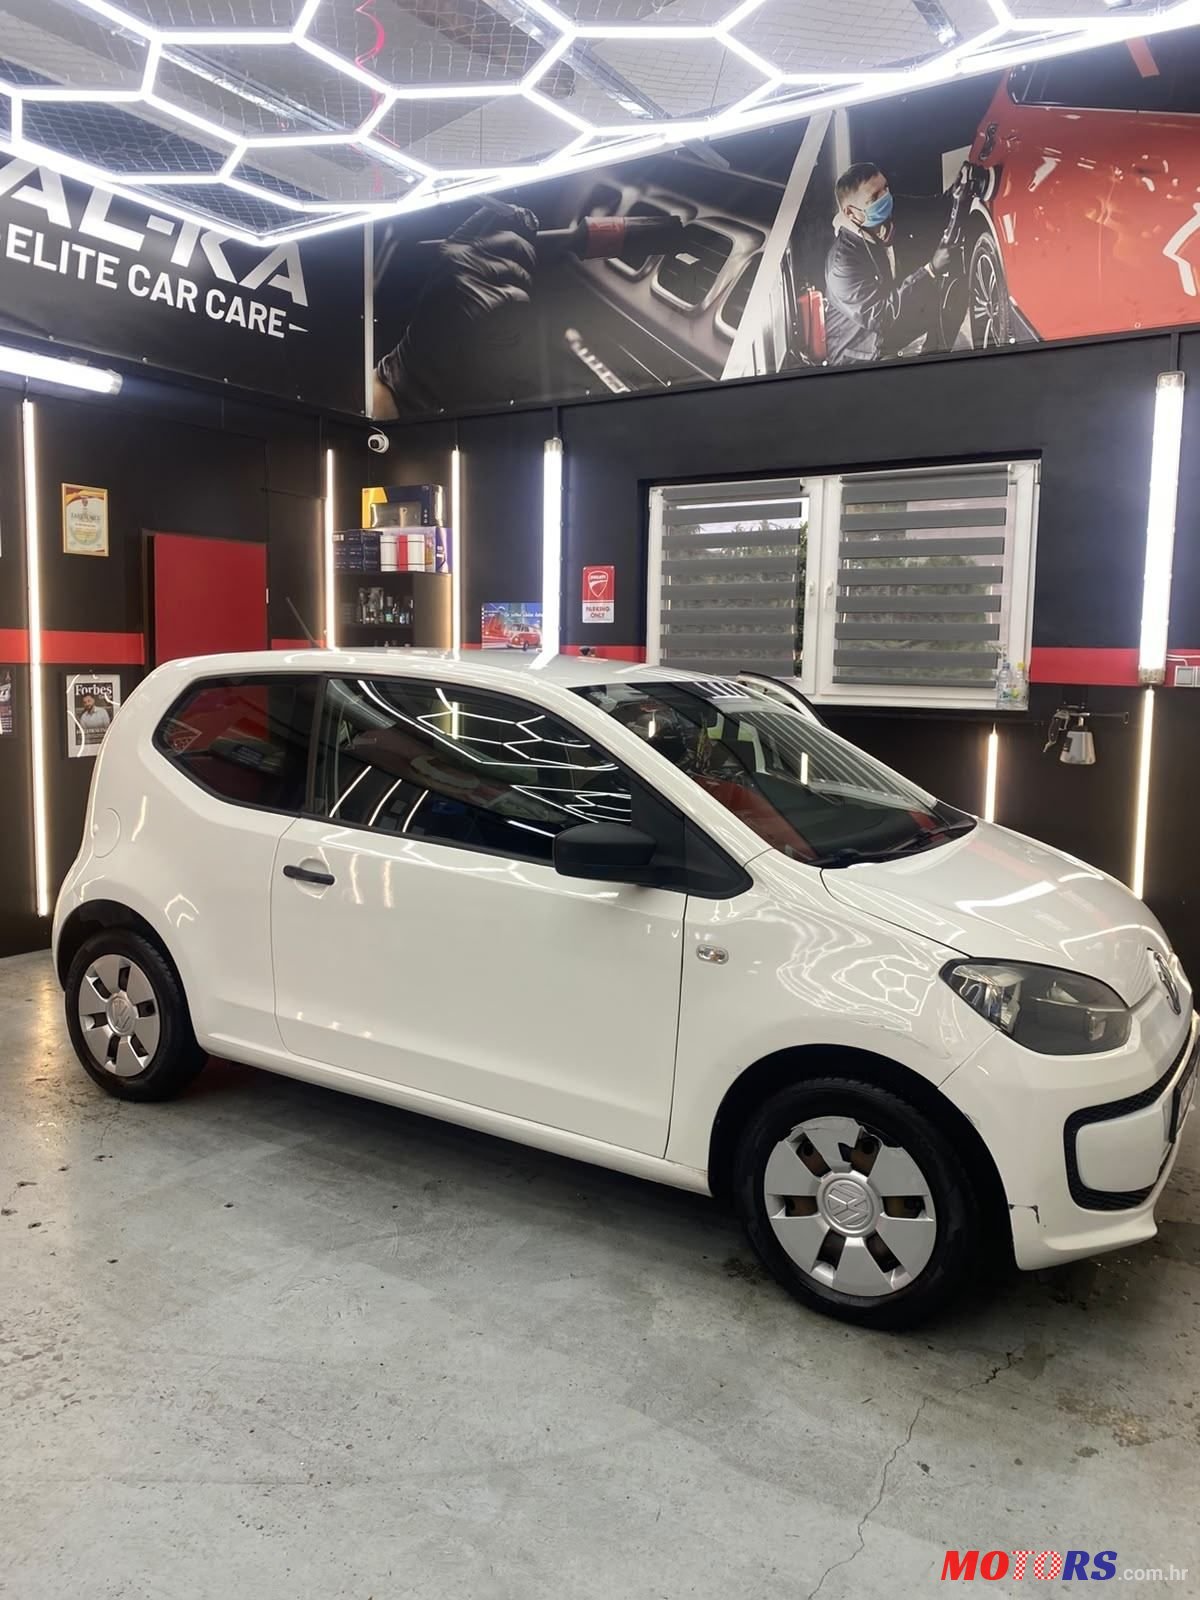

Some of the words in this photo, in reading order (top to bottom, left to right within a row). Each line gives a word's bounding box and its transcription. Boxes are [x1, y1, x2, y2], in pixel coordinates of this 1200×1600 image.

[5, 222, 121, 290] ELITE
[127, 263, 199, 314] CAR
[205, 288, 287, 339] CARE
[75, 684, 112, 696] Forbes
